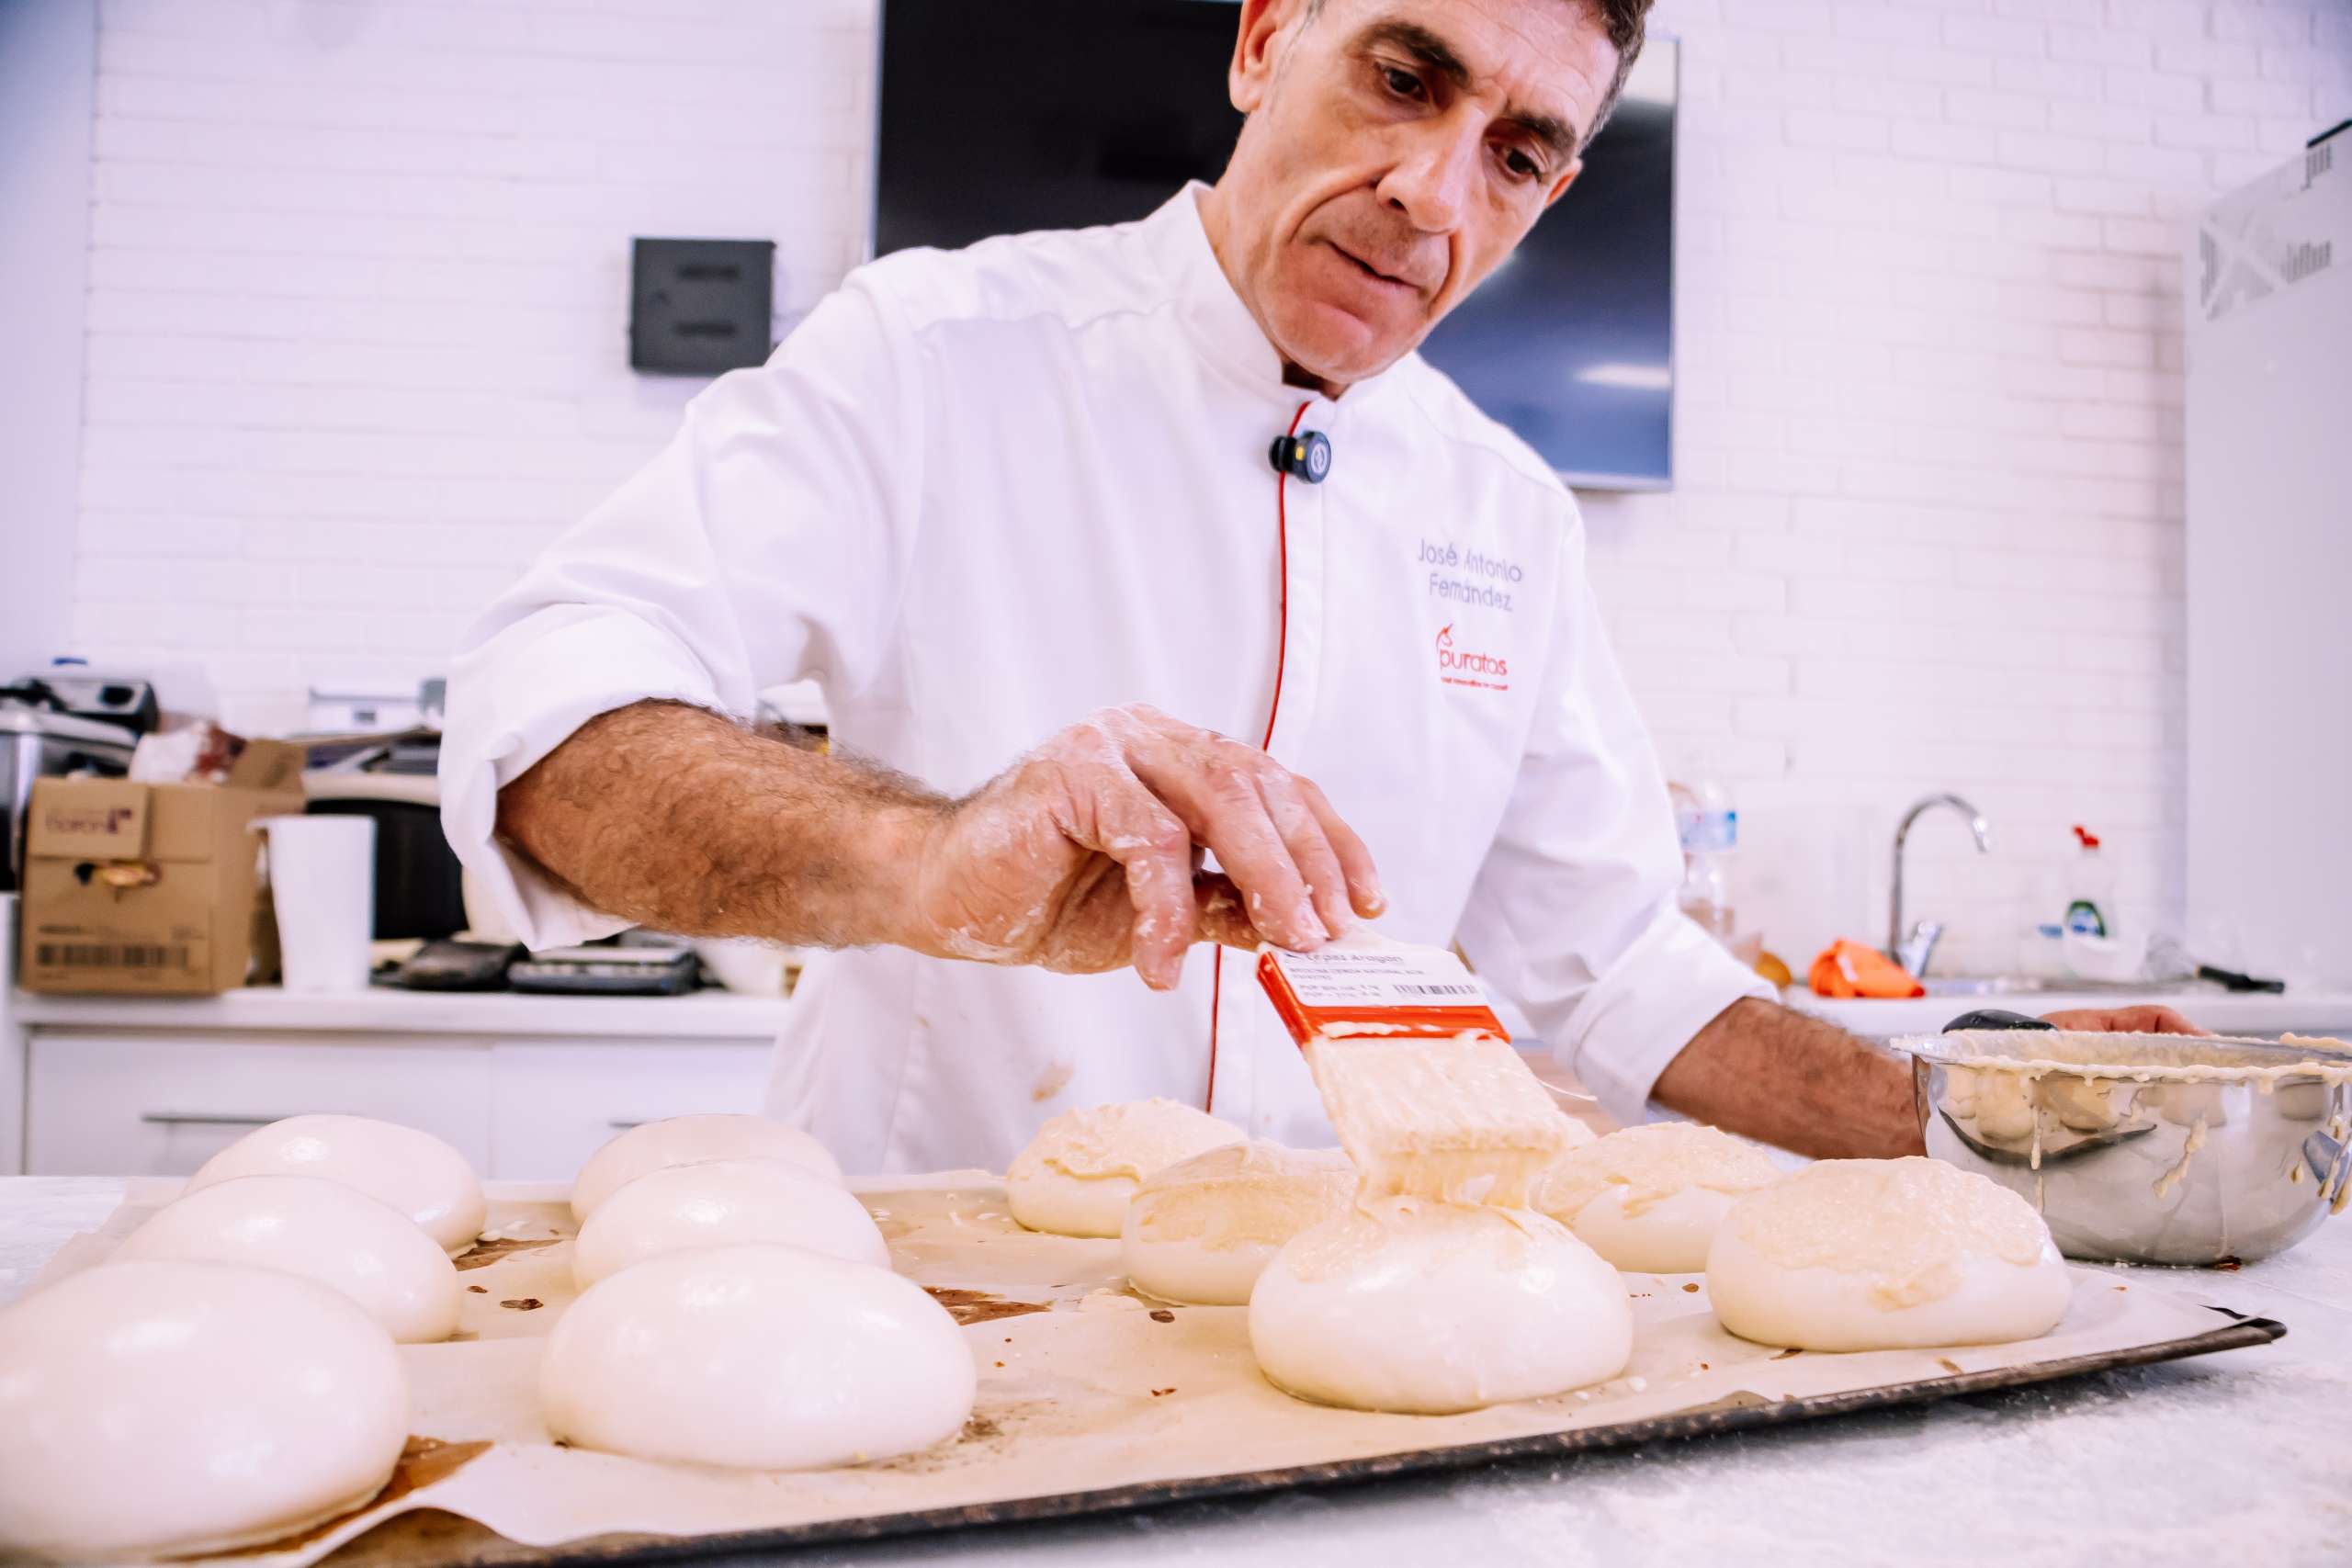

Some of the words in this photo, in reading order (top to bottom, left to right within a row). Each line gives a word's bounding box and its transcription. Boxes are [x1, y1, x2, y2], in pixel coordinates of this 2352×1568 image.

[1418, 537, 1458, 567] José
[1464, 548, 1522, 582] Antonio
[1440, 649, 1508, 675] puratos
